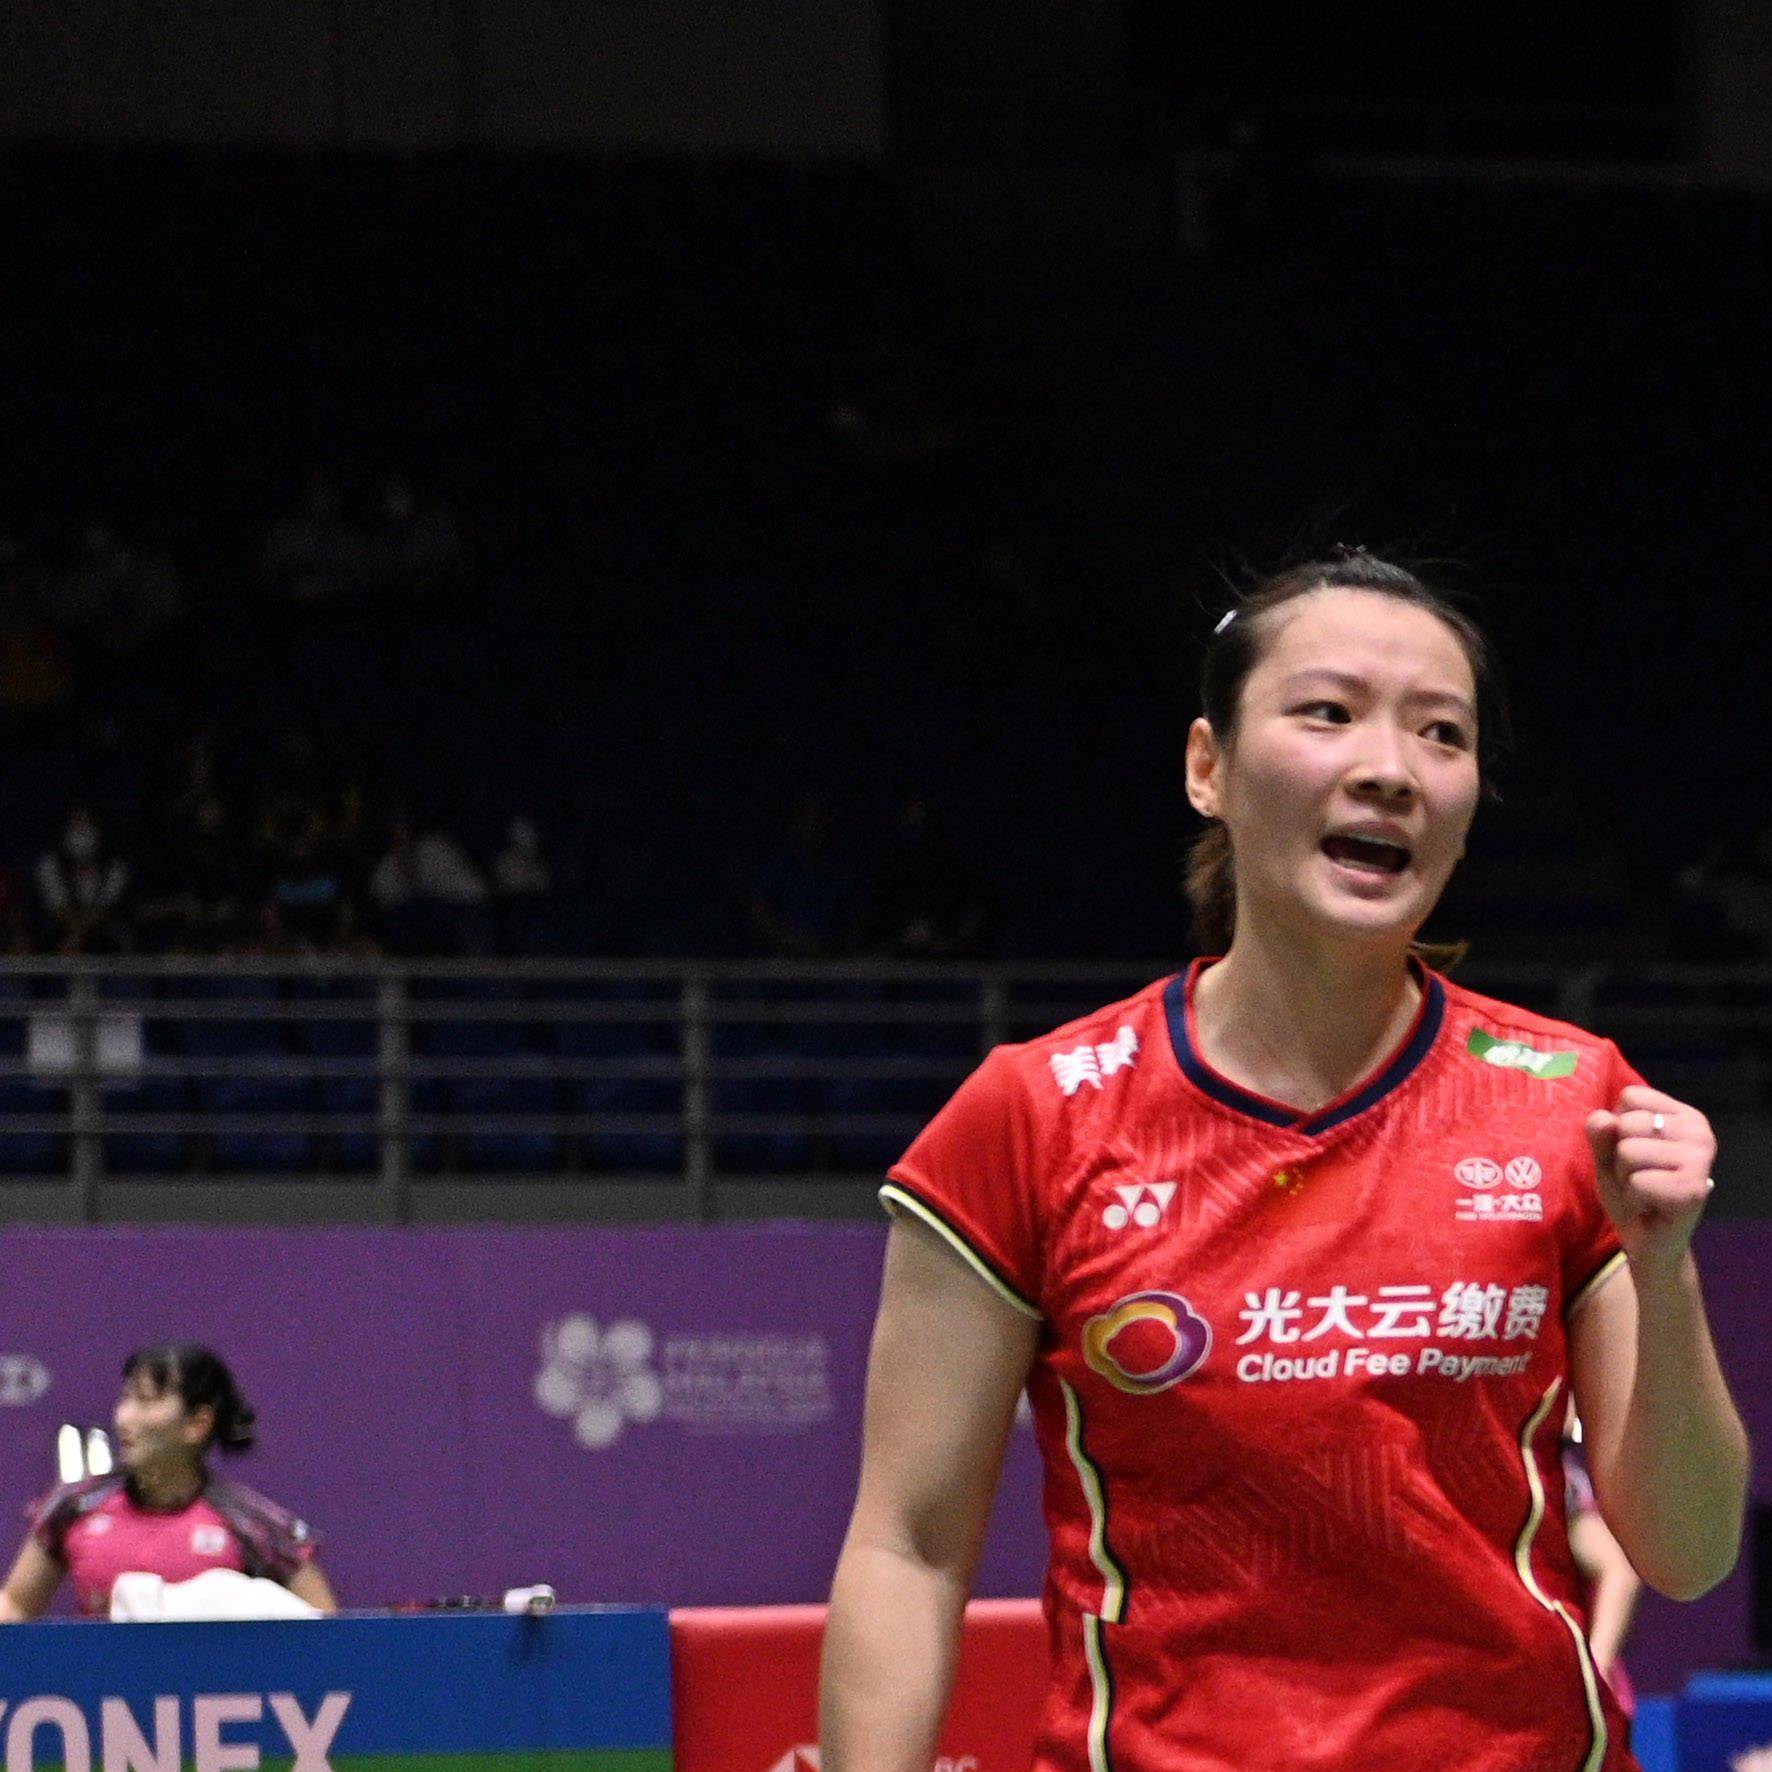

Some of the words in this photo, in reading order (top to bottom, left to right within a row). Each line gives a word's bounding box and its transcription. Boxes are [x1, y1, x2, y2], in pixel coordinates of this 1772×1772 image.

[1235, 1280, 1549, 1345] 光大云缴费
[1236, 1350, 1339, 1382] Cloud
[1343, 1347, 1411, 1377] Fee
[1416, 1347, 1532, 1383] Payment
